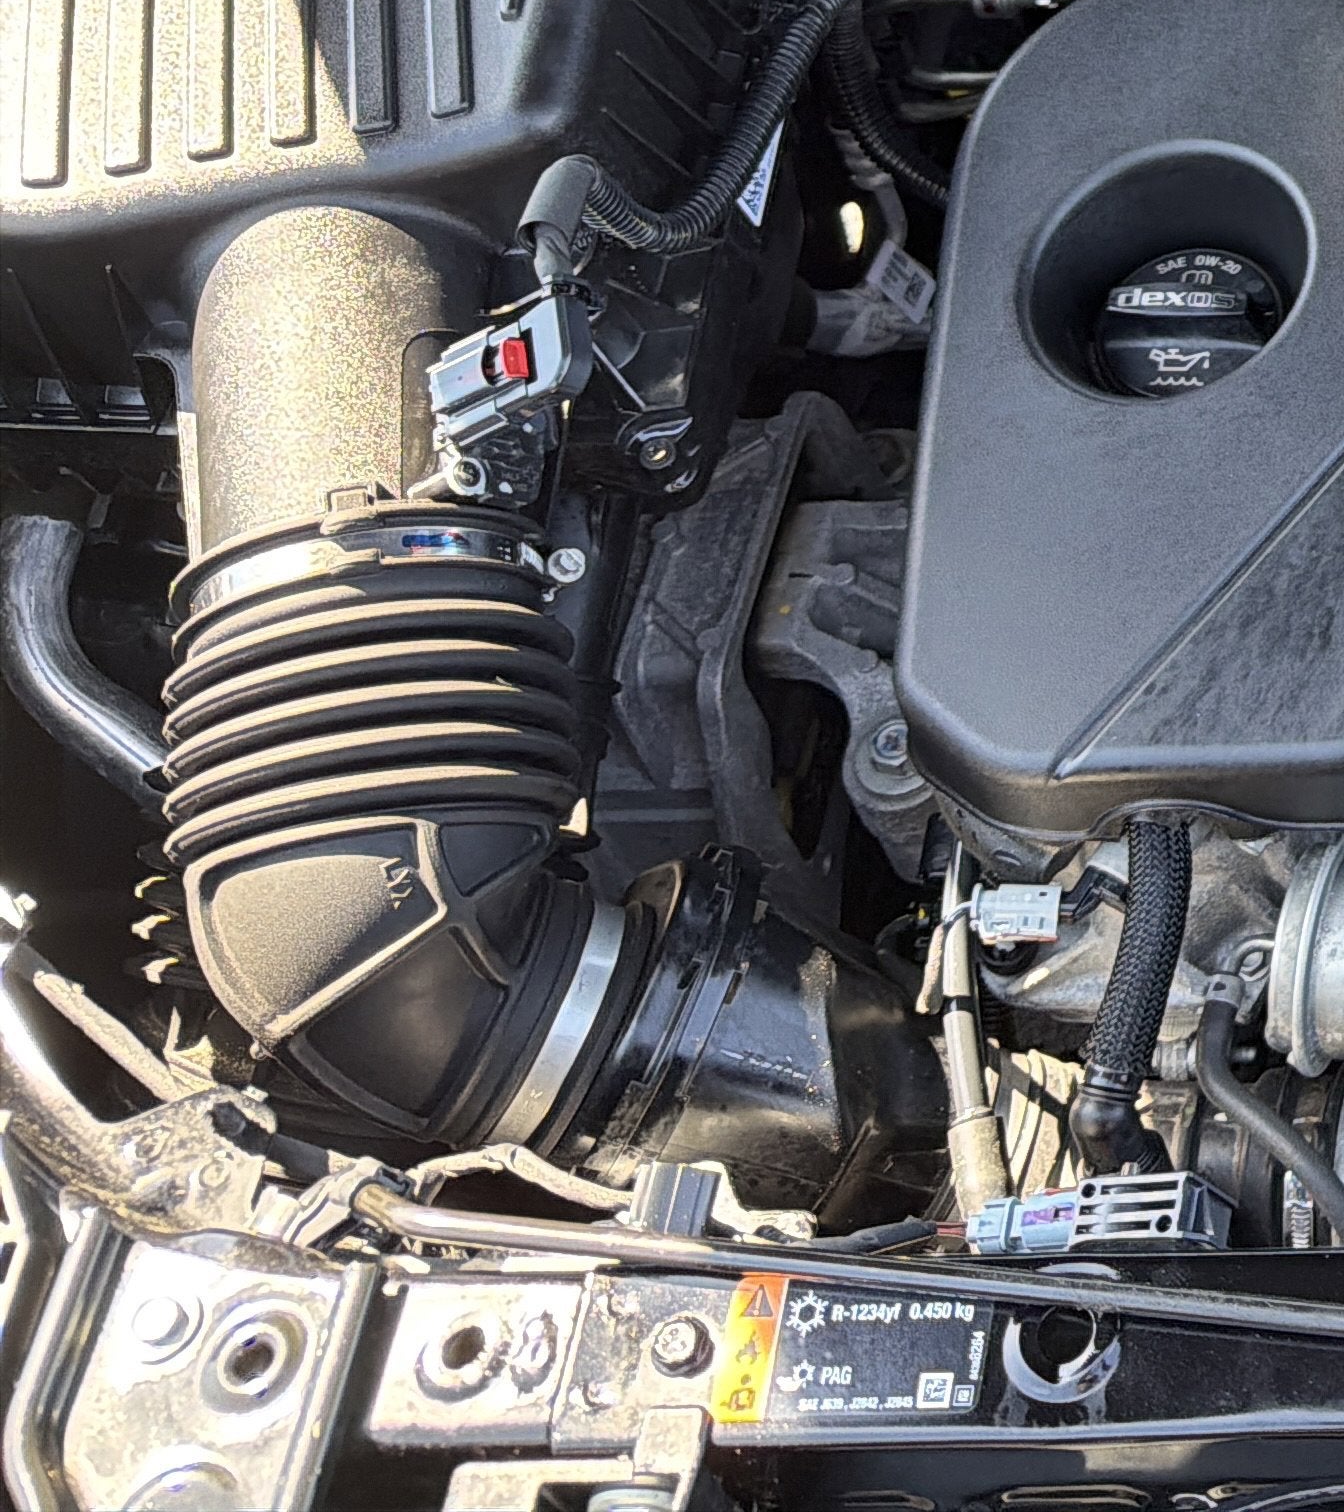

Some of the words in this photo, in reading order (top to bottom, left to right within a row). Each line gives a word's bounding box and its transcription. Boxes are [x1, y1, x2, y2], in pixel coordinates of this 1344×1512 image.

[1155, 256, 1188, 275] SAE
[1194, 255, 1242, 275] 0W-20
[1117, 287, 1236, 308] dexos
[831, 1302, 902, 1324] R-1234yf
[908, 1302, 953, 1320] 0.450
[954, 1302, 975, 1322] kg
[820, 1366, 853, 1385] PAG
